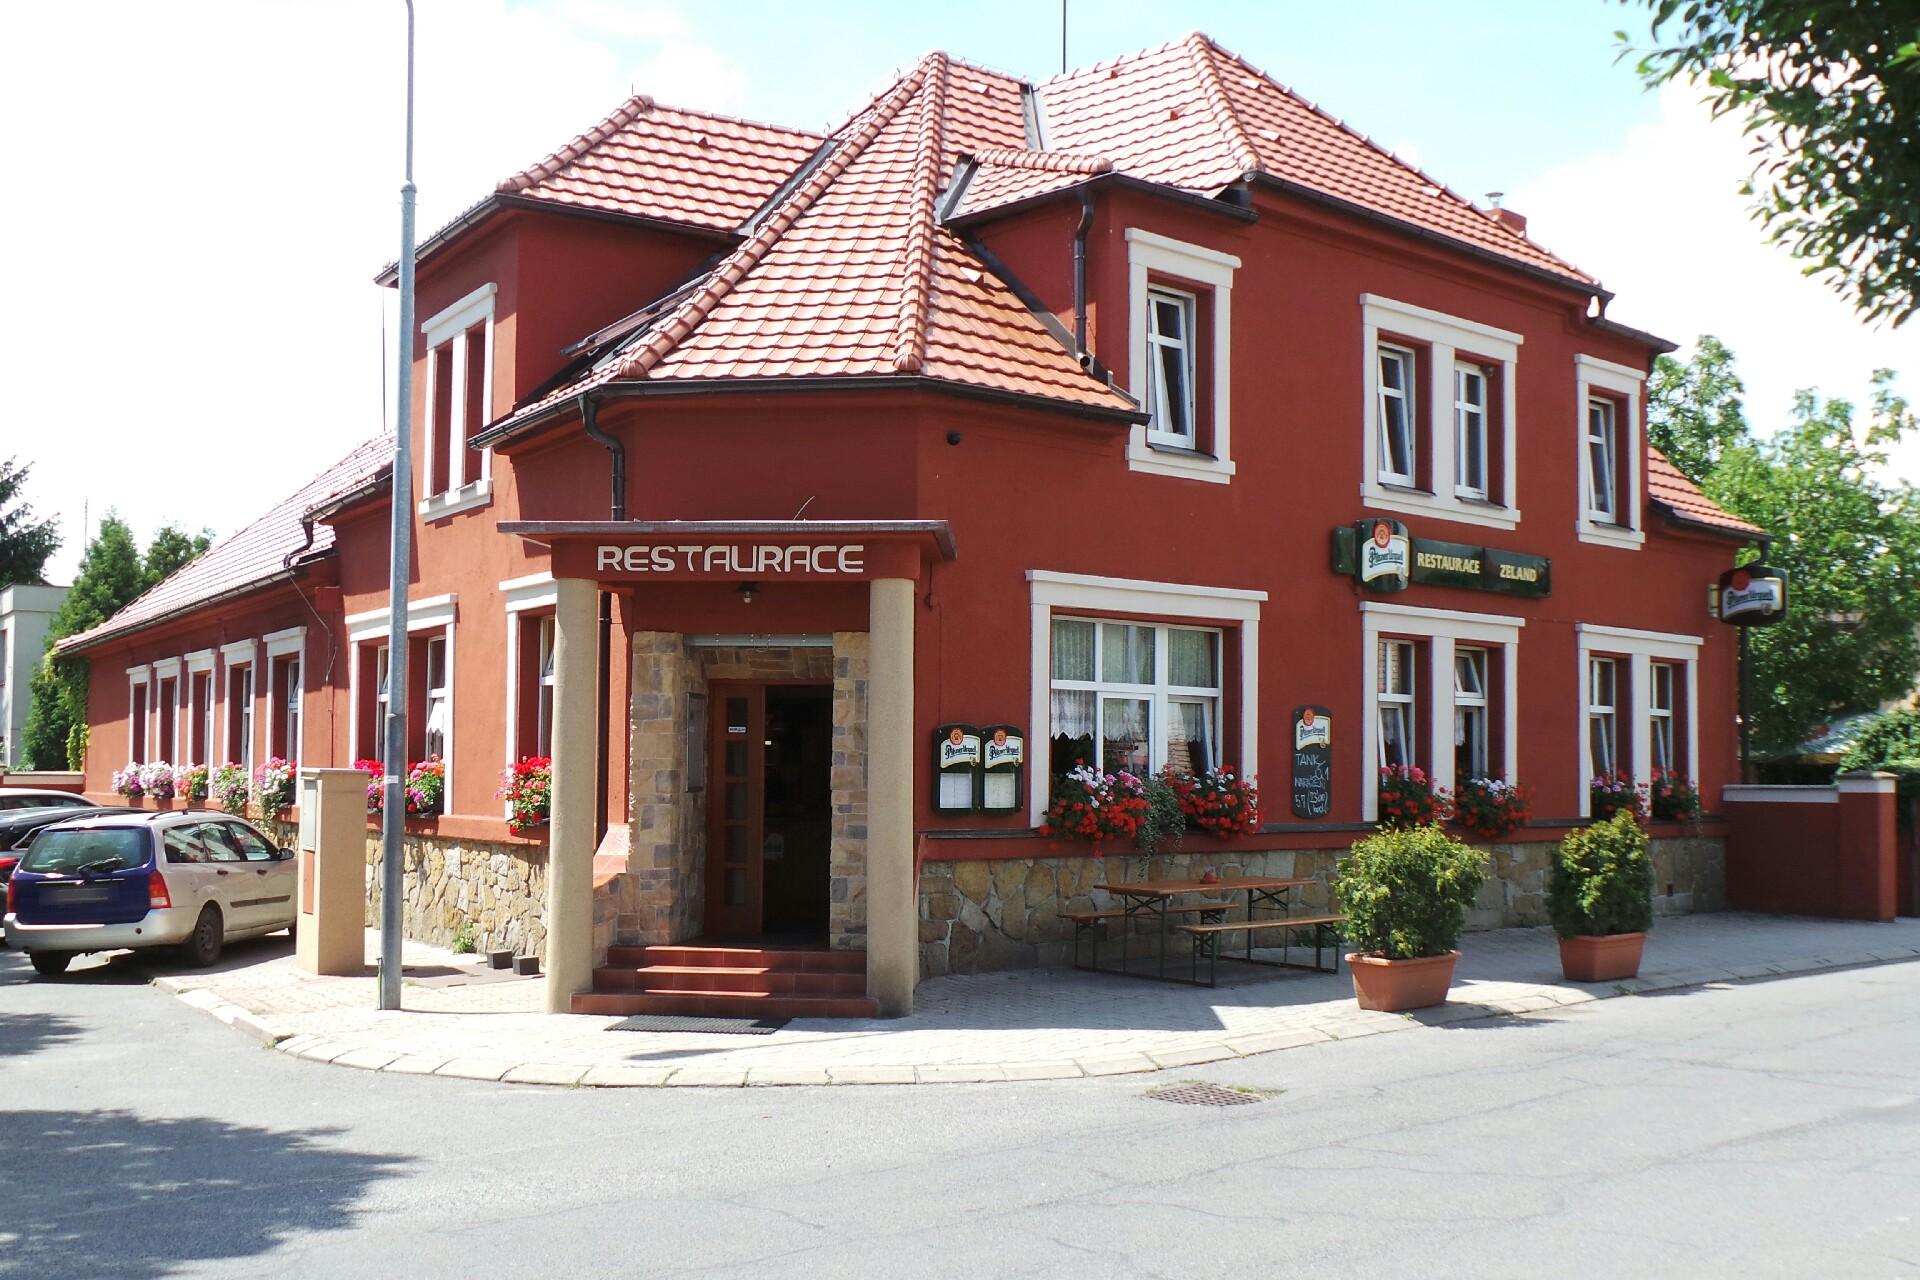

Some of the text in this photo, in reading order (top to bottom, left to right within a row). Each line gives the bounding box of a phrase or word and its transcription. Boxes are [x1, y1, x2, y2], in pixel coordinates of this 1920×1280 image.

[597, 544, 865, 573] RESTAURACE
[1416, 552, 1537, 582] RESTAURACE ZELAND
[1295, 753, 1320, 767] TANK
